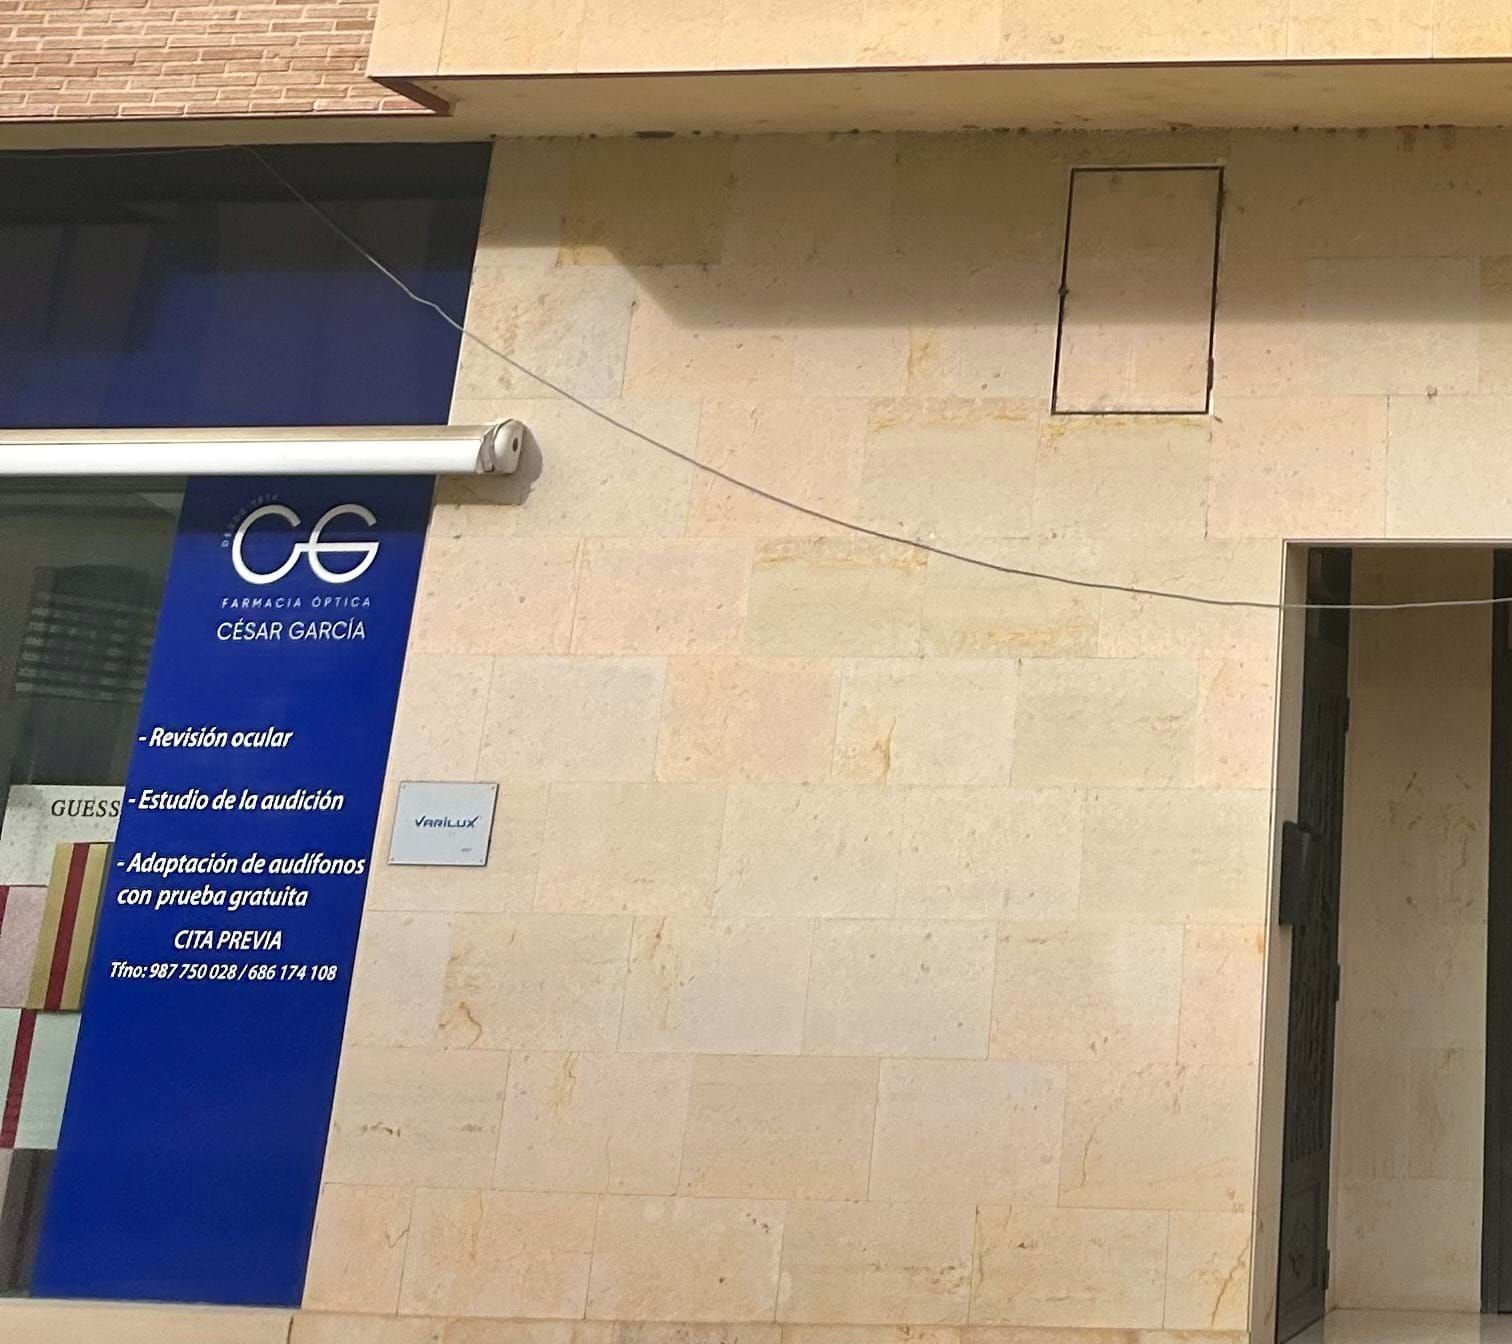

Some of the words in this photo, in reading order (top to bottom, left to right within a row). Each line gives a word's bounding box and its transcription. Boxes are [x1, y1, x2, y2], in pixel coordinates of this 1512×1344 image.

[221, 597, 301, 609] FARMACIA
[311, 595, 371, 608] ÓPTICA
[217, 617, 283, 640] CÉSAR
[288, 616, 366, 640] GARCÍA
[149, 726, 227, 748] Revisión
[231, 726, 294, 748] ocular
[51, 799, 120, 817] GUESS
[138, 789, 208, 811] Estudio
[212, 789, 236, 811] de
[239, 789, 258, 811] la
[261, 789, 344, 811] audición
[126, 852, 238, 878] Adaptación
[241, 853, 265, 874] de
[268, 852, 366, 875] audífonos
[117, 887, 152, 905] con
[154, 884, 226, 910] prueba
[228, 885, 308, 911] gratuita
[174, 930, 213, 950] CITA
[216, 930, 282, 951] PREVIA
[110, 961, 148, 979] Tfno:
[149, 963, 178, 980] 987
[180, 963, 207, 980] 750
[209, 963, 237, 980] 028
[248, 964, 276, 980] 686
[280, 964, 306, 980] 174
[310, 964, 338, 981] 108
